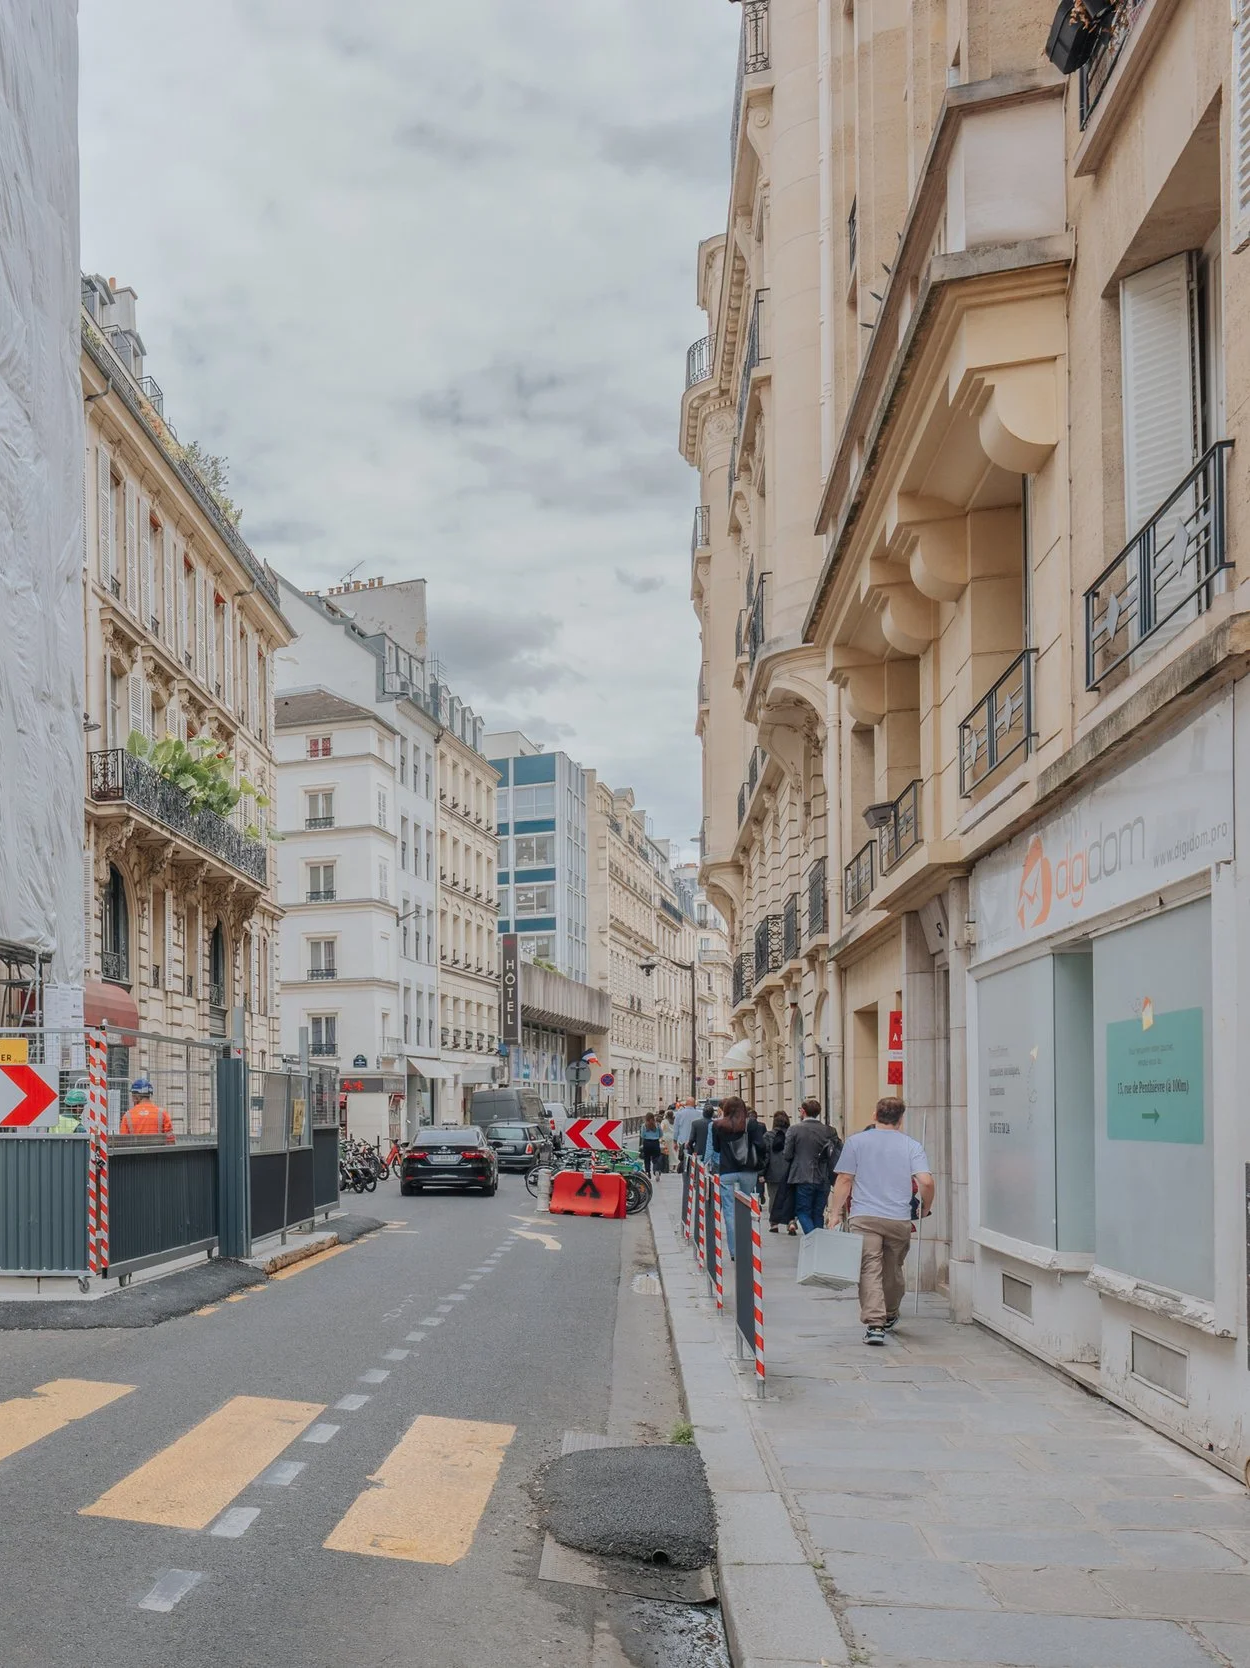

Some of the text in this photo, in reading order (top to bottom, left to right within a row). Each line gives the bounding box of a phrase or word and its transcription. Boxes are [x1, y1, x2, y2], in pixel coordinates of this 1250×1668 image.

[1055, 815, 1146, 909] digidom
[1152, 821, 1228, 869] www.digidom.pro
[505, 959, 516, 1025] HÔTEL
